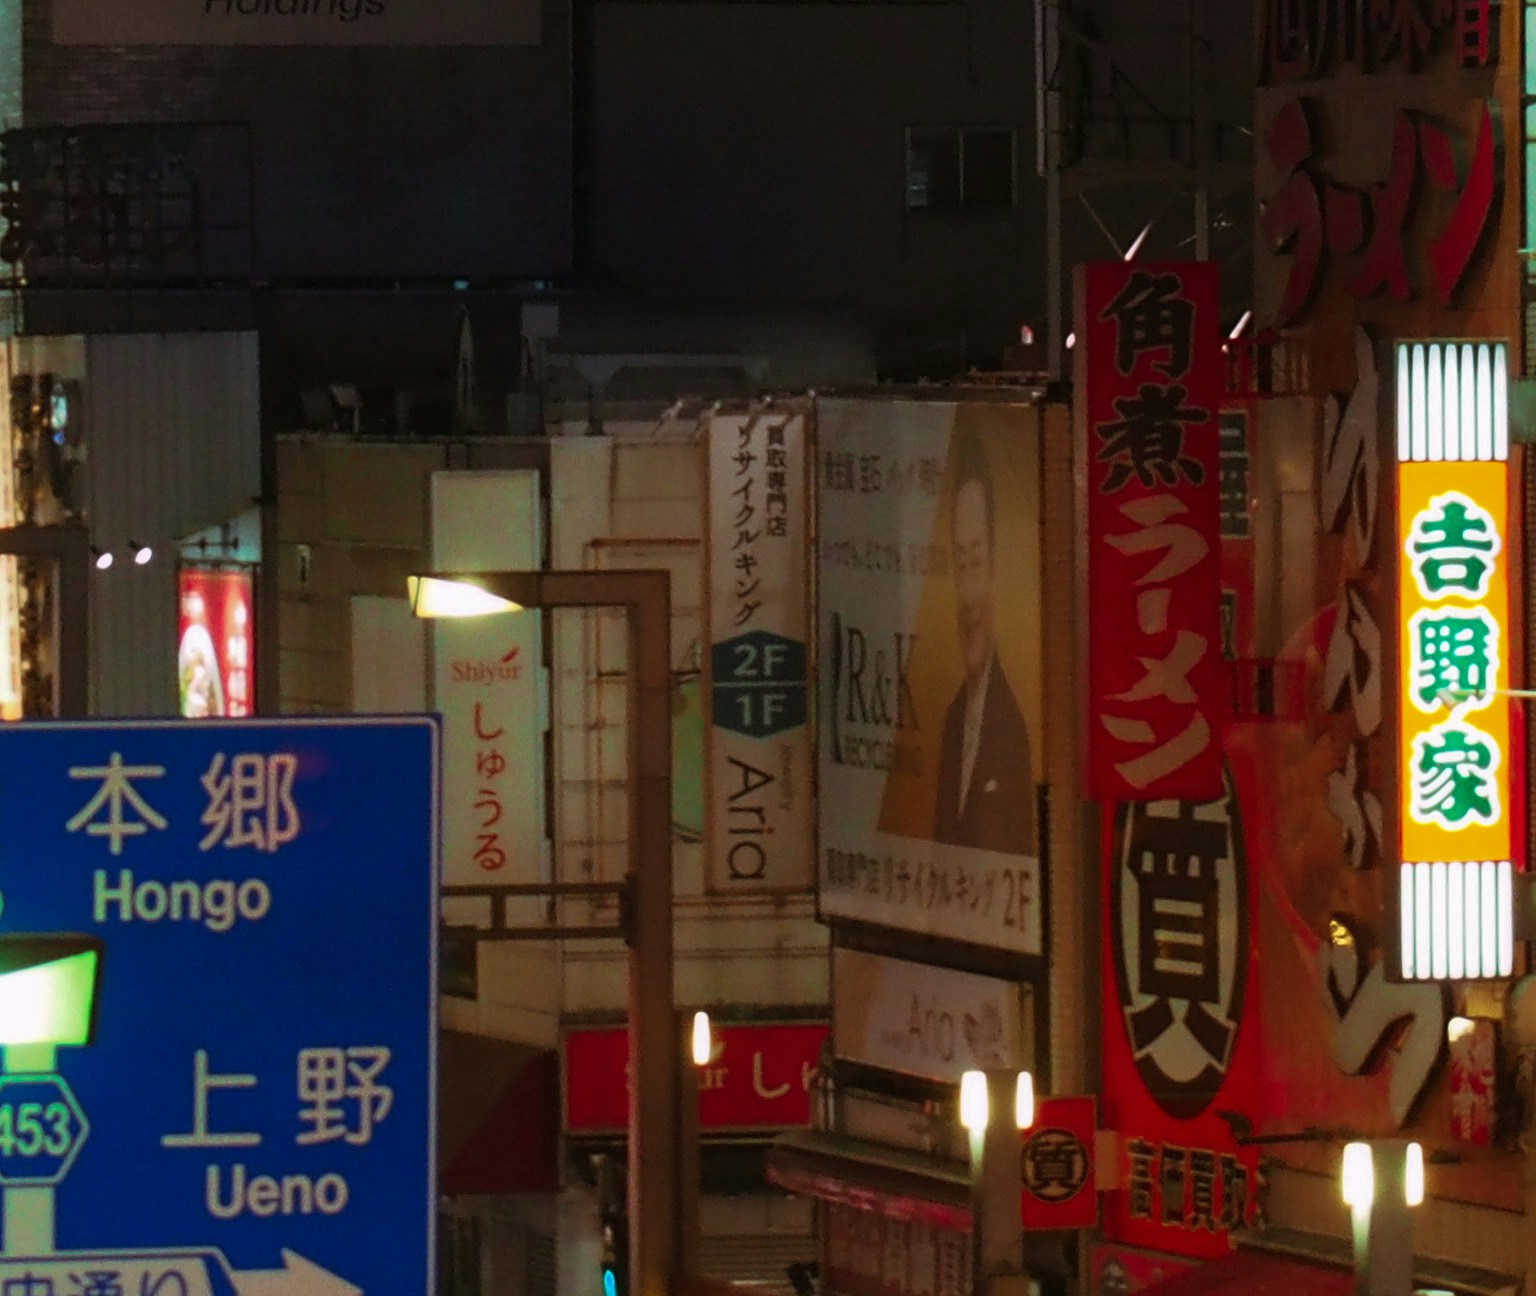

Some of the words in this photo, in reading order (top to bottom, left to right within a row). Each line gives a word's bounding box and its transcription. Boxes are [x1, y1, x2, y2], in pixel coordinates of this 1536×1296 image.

[1098, 270, 1213, 792] 角煮ラーメン
[734, 644, 786, 676] 2F
[736, 695, 785, 725] 1F
[1408, 494, 1498, 826] 吉野家
[66, 751, 301, 854] 本郷
[727, 755, 775, 881] Aria
[93, 869, 271, 931] Hongo
[161, 1046, 394, 1148] 上野
[205, 1164, 348, 1218] Ueno
